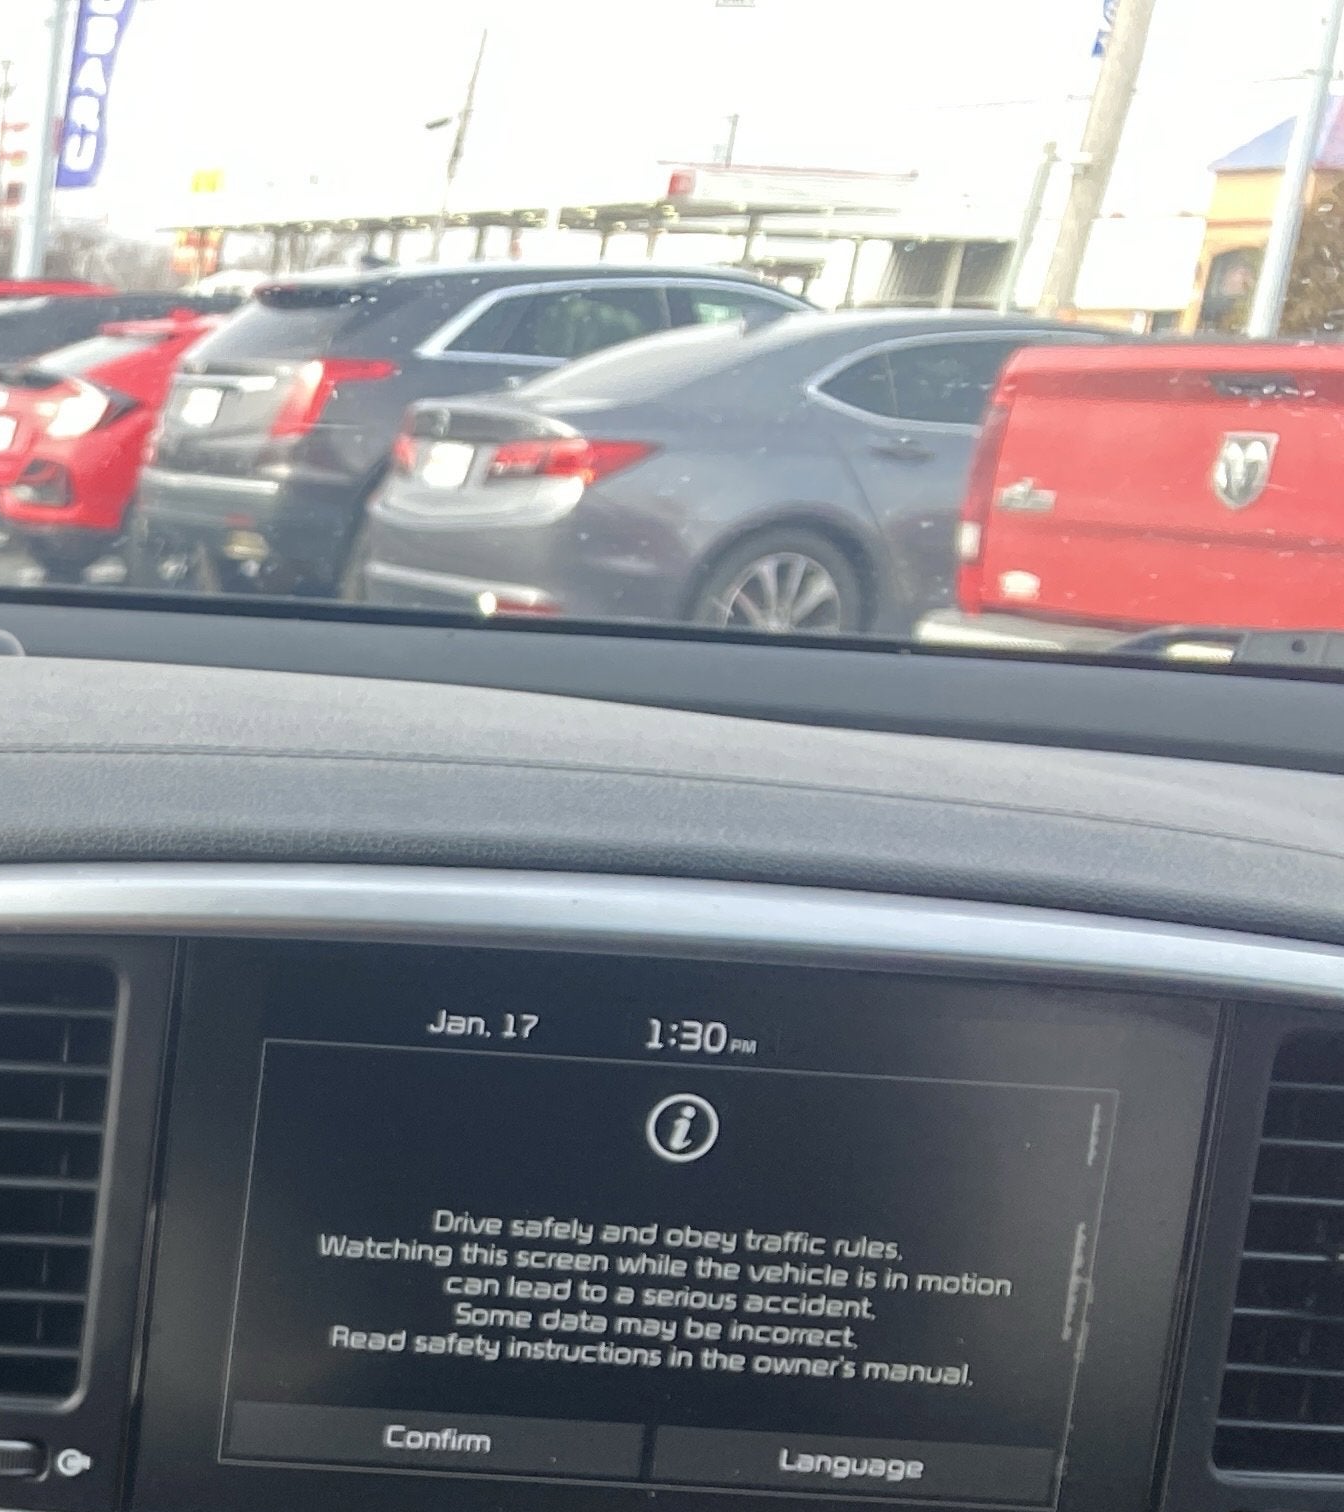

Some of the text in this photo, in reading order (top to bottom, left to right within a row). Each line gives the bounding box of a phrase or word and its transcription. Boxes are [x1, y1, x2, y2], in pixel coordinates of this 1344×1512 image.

[427, 1009, 491, 1038] Jan.
[501, 1013, 540, 1038] 17
[432, 1209, 904, 1262] Drive safely and obey traffic rules.
[318, 1233, 1013, 1298] Watching this screen while the vehicle is in motion
[444, 1275, 500, 1298] can
[506, 1275, 572, 1301] lead
[578, 1280, 608, 1304] to
[614, 1285, 635, 1306] a
[641, 1285, 738, 1312] serious
[454, 1301, 533, 1329] Some
[539, 1308, 608, 1334] data
[615, 1315, 678, 1342] may
[683, 1316, 722, 1342] be
[329, 1324, 407, 1352] Read
[413, 1331, 501, 1361] safety
[506, 1335, 662, 1369] instructions
[666, 1345, 693, 1370] in
[699, 1347, 746, 1373] the
[751, 1354, 856, 1380] owner's
[383, 1424, 492, 1454] Confirm
[778, 1447, 924, 1482] Language
